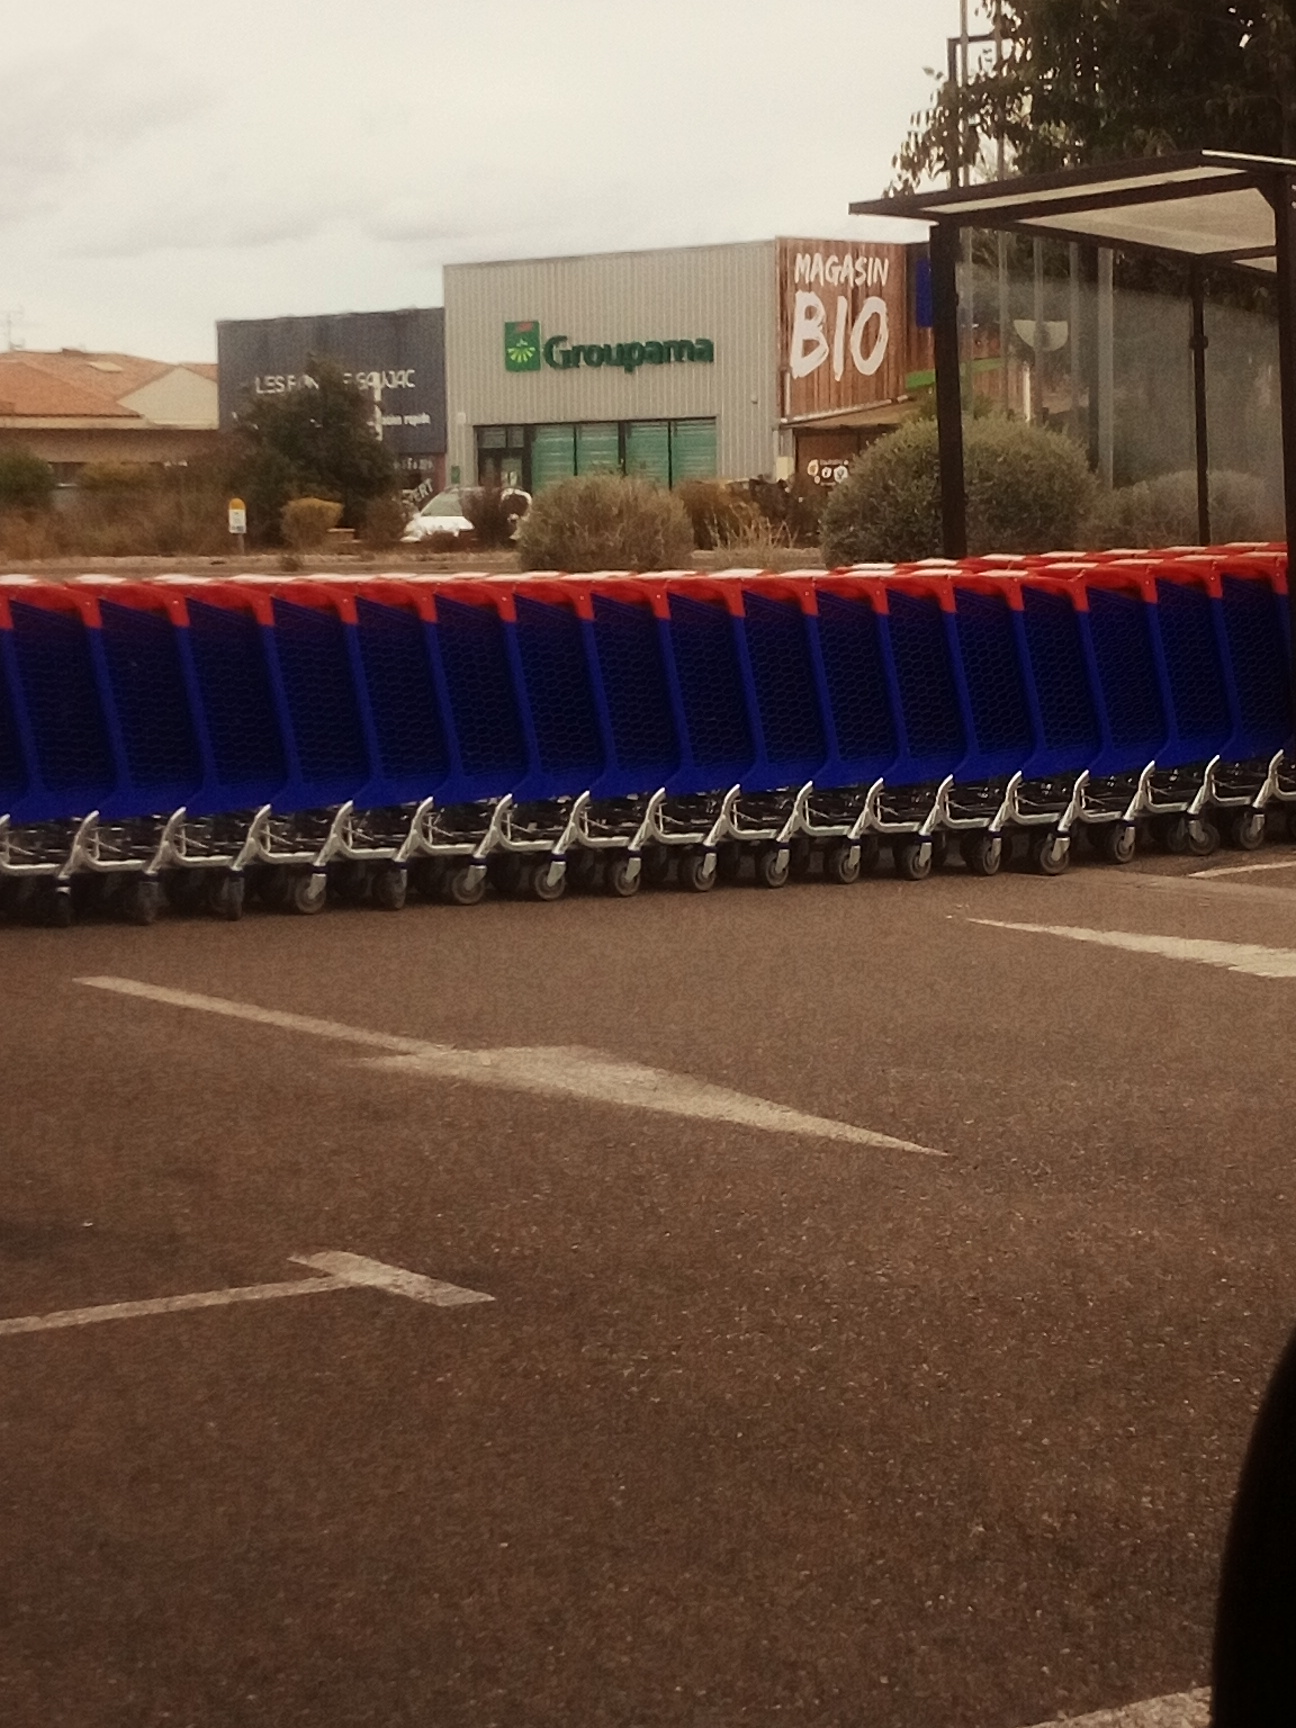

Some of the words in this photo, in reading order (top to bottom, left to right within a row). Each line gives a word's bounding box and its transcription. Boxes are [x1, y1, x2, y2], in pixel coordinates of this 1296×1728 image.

[794, 252, 889, 288] MAGASIN
[544, 335, 714, 373] Groupama
[790, 289, 890, 382] BIO
[255, 374, 285, 395] LES
